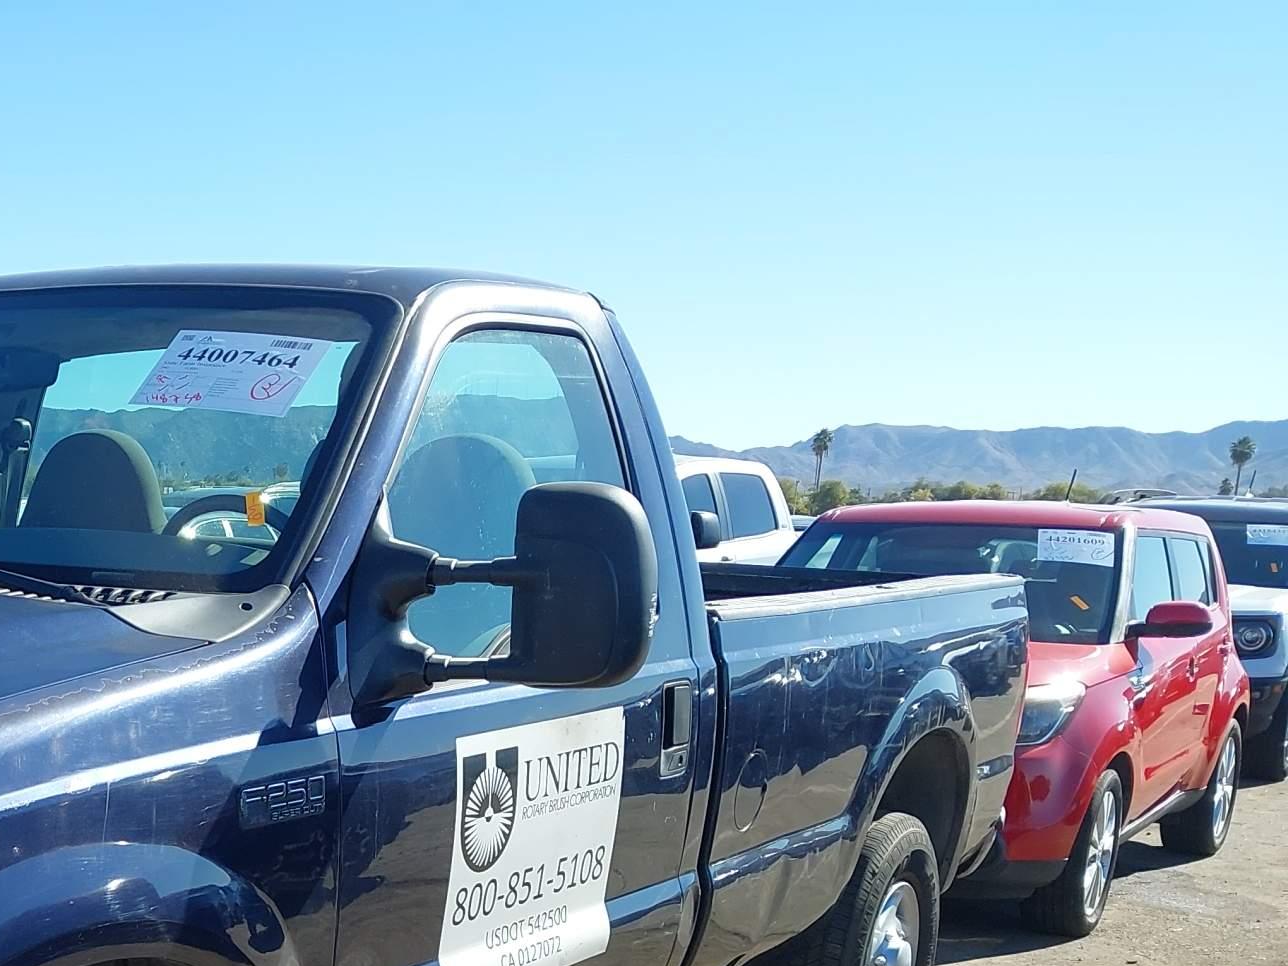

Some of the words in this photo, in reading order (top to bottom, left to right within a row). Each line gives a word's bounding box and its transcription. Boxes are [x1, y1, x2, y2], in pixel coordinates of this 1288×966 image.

[177, 347, 300, 369] 44007464
[524, 741, 620, 802] UNITED
[521, 800, 550, 821] ROTARY
[549, 795, 570, 813] BRUSH
[569, 783, 617, 807] CORPORATION
[452, 845, 606, 926] 800-851-5108
[485, 918, 526, 950] USDOT
[527, 904, 568, 936] 542500
[517, 935, 563, 966] 0127072
